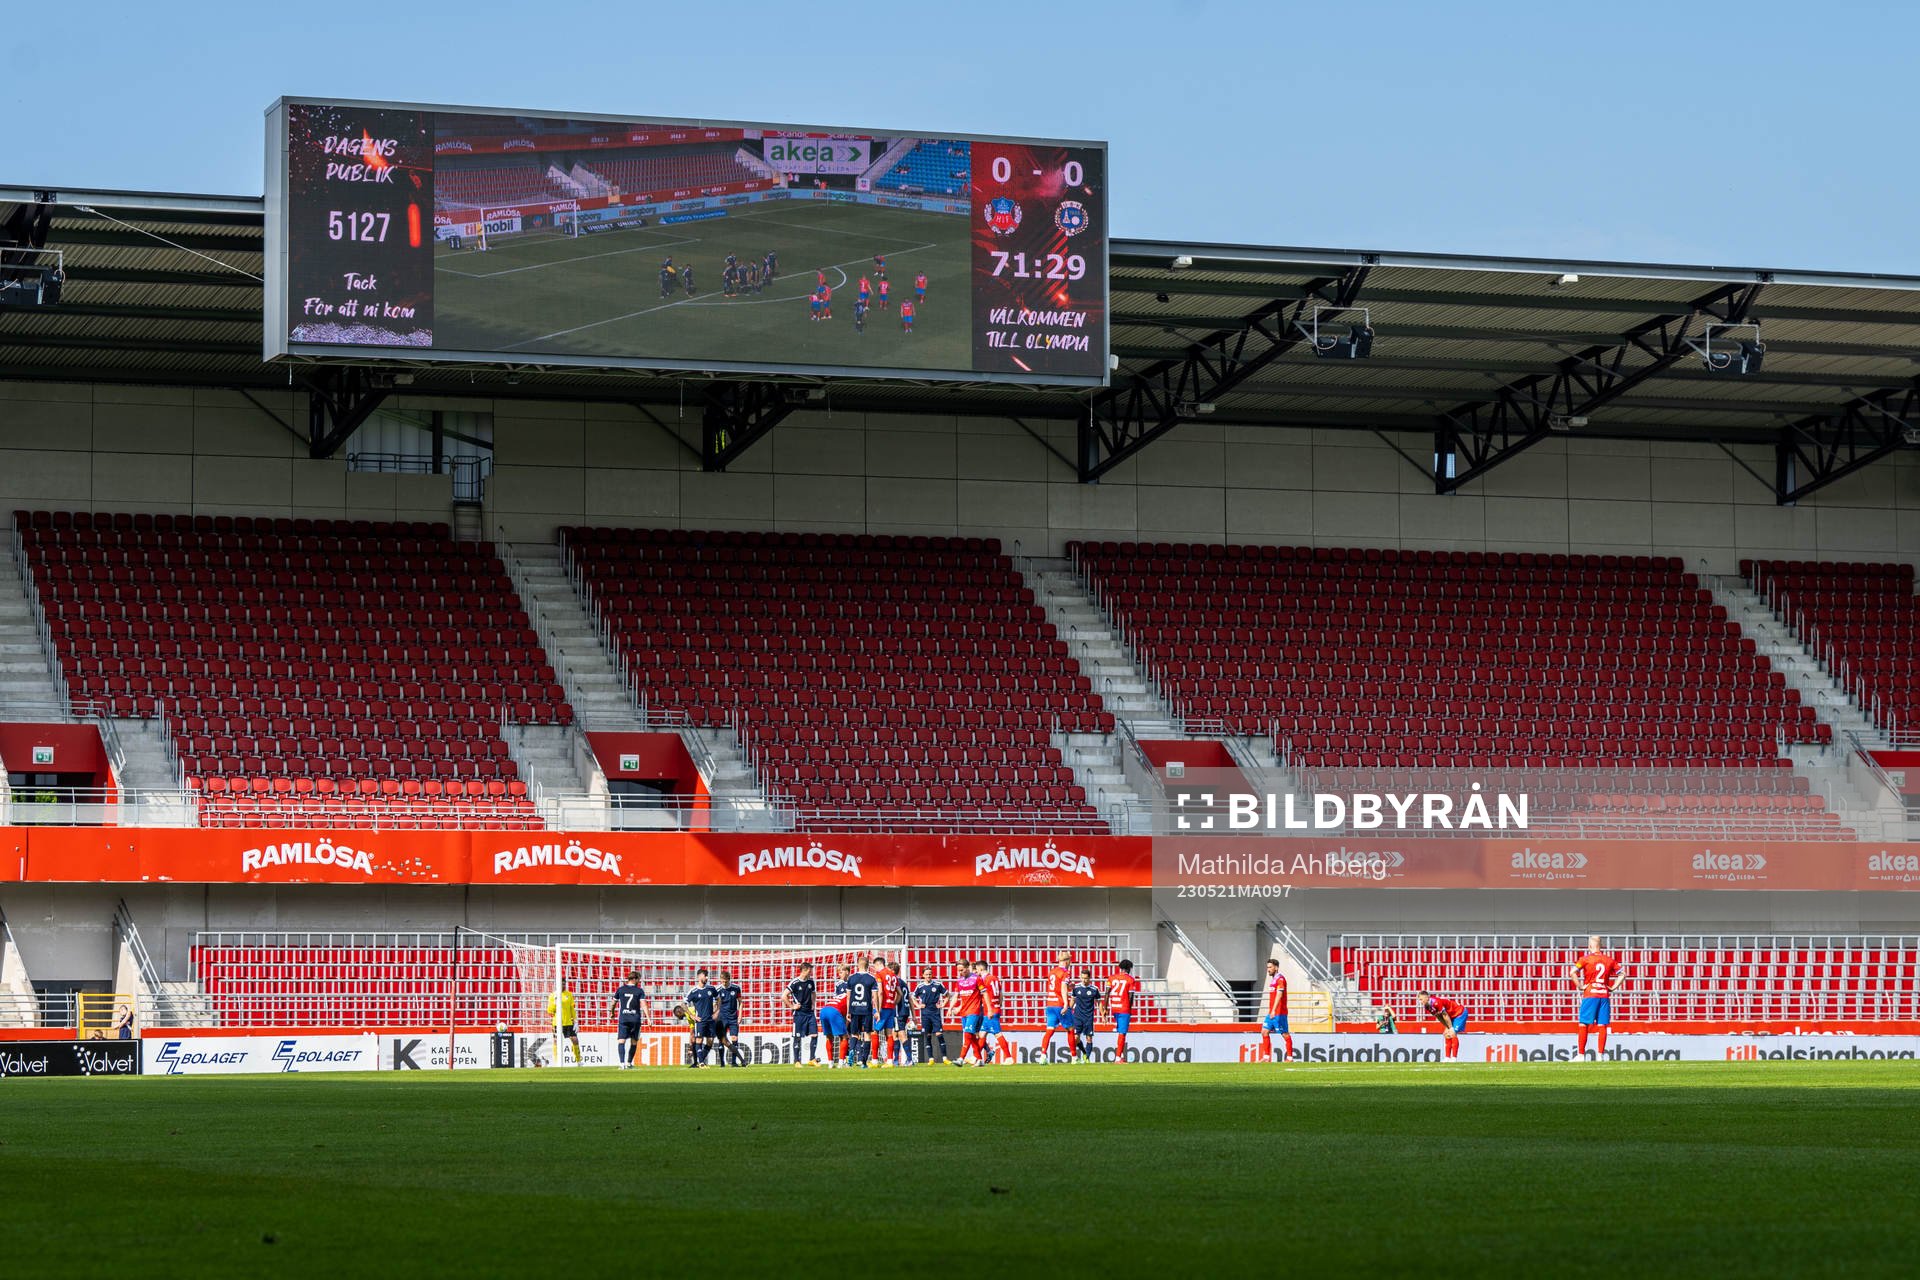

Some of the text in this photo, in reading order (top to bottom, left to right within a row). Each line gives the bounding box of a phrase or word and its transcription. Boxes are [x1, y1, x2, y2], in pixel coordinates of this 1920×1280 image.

[324, 136, 398, 156] DAGENS
[770, 140, 834, 162] akea
[325, 162, 396, 184] PUBLIK
[992, 156, 1012, 183] 0
[1064, 160, 1084, 187] 0
[328, 209, 391, 243] 5127
[990, 250, 1087, 281] 71:29
[343, 272, 378, 291] Tack
[338, 299, 360, 318] att
[362, 302, 381, 318] ni
[382, 301, 416, 319] kom
[985, 330, 1090, 352] TILL OLYMPIA
[242, 838, 374, 876] RAMLÖSA
[494, 839, 622, 878] RAMLÖSA
[738, 842, 862, 879] RAMLÖSA
[975, 843, 1095, 880] RAMLÖSA
[1511, 847, 1564, 869] akea
[1692, 849, 1744, 870] akea
[1868, 850, 1919, 871] akea
[885, 974, 897, 992] 33
[1049, 974, 1056, 991] 3
[1595, 963, 1605, 983] 2
[854, 983, 865, 1000] 9
[1110, 979, 1127, 996] 27
[624, 993, 634, 1009] 7
[431, 1046, 473, 1055] KAPTAL
[564, 1056, 603, 1064] RUPEN
[0, 1053, 48, 1073] Valvet
[84, 1052, 133, 1072] Valvet
